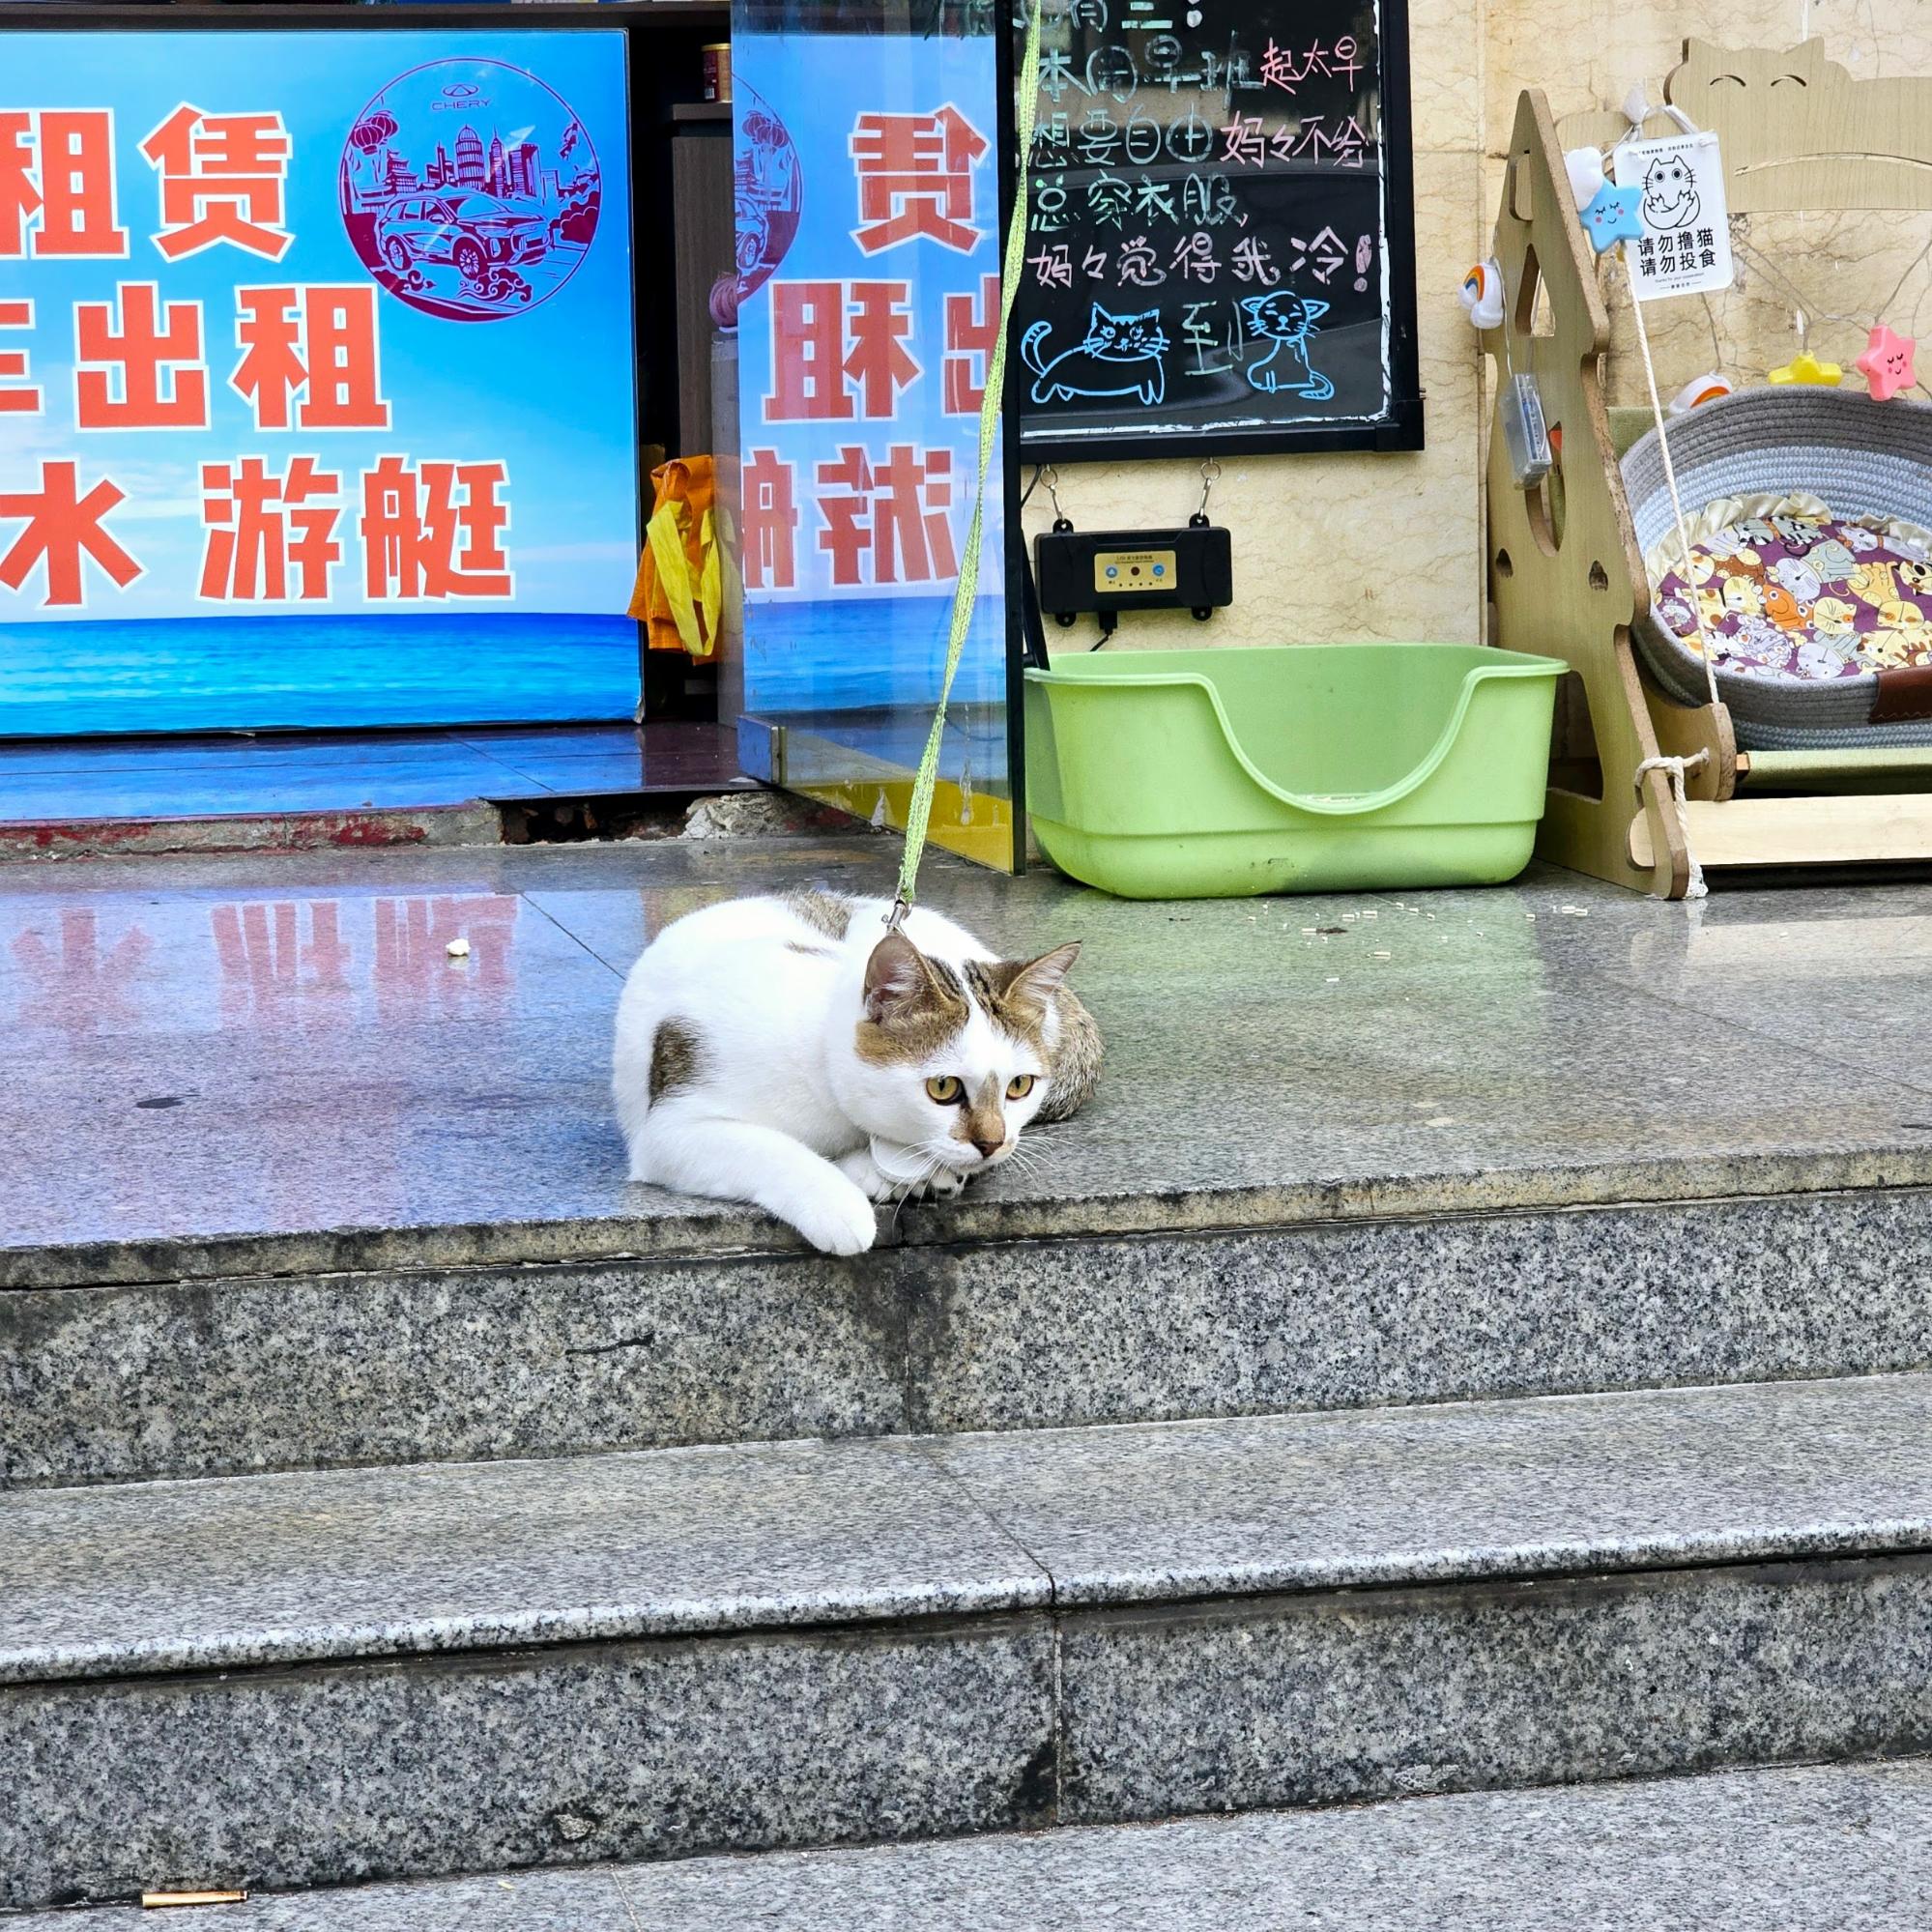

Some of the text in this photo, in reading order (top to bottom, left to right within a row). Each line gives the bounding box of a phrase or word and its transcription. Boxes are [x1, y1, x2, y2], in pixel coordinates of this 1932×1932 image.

[431, 99, 491, 111] CHERY
[1637, 227, 1714, 257] 请勿撸猫
[1639, 248, 1716, 277] 请勿投食
[199, 456, 513, 601] 游艇
